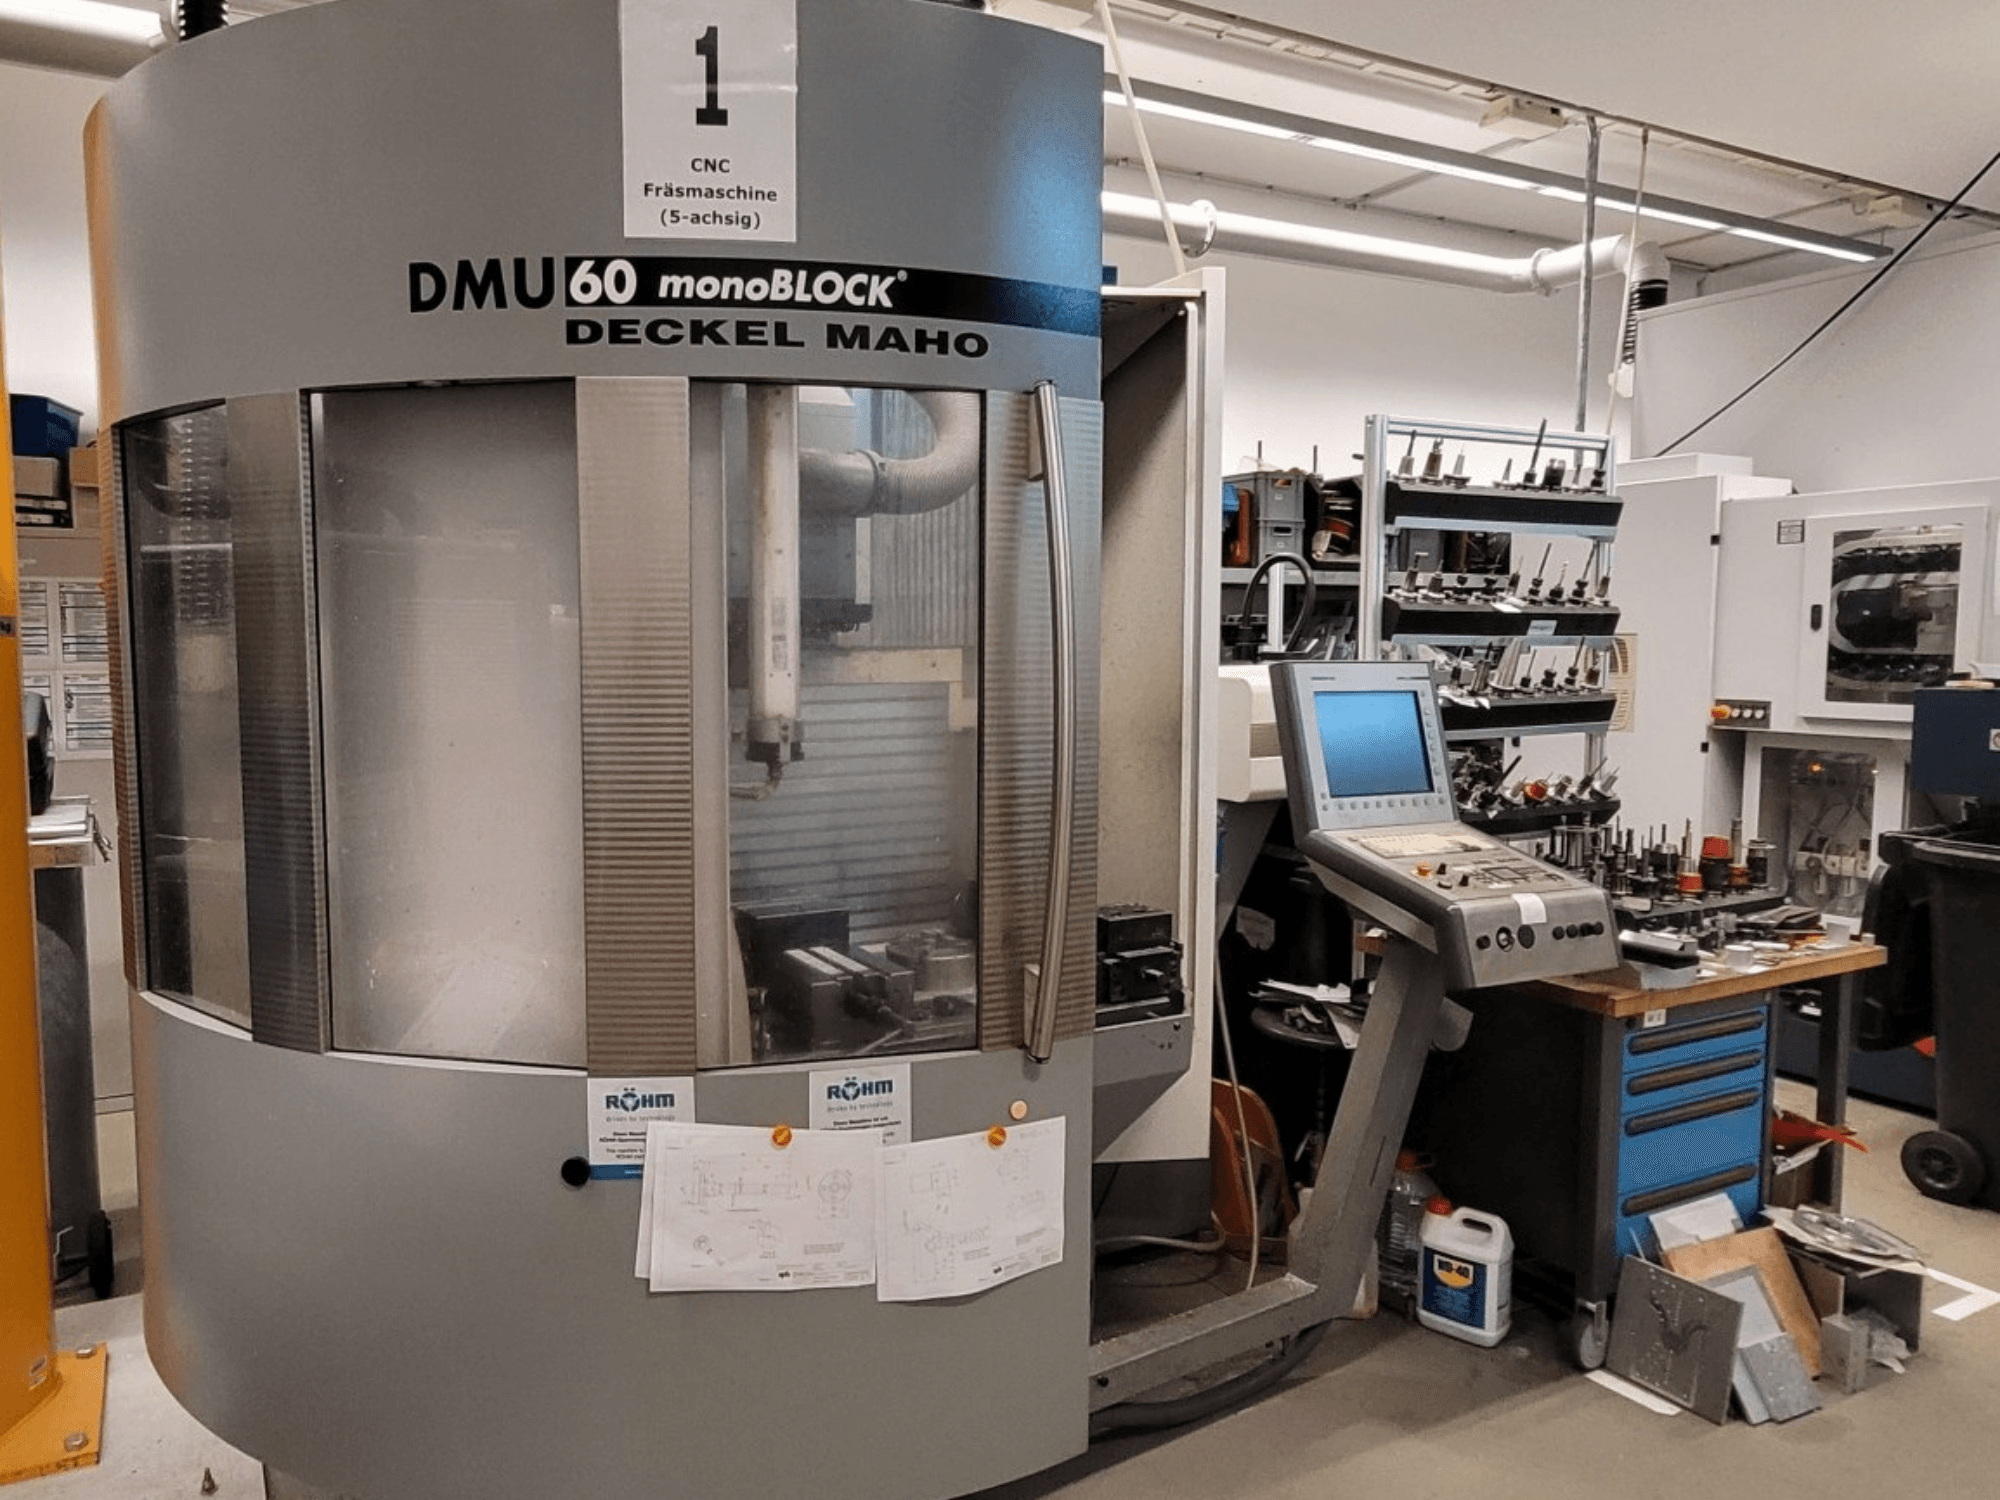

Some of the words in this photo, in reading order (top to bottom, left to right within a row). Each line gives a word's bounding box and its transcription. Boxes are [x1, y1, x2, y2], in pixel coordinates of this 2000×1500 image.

[695, 25, 728, 126] 1
[690, 157, 731, 174] CNC
[643, 182, 778, 202] Fräsmaschine
[660, 208, 761, 230] (5-achsig)
[408, 256, 556, 313] DMU
[569, 258, 637, 305] 60
[565, 318, 805, 348] DECKEL
[825, 322, 989, 359] MAHO
[605, 1087, 675, 1112] RÖHM
[826, 1076, 893, 1101] RÖHM
